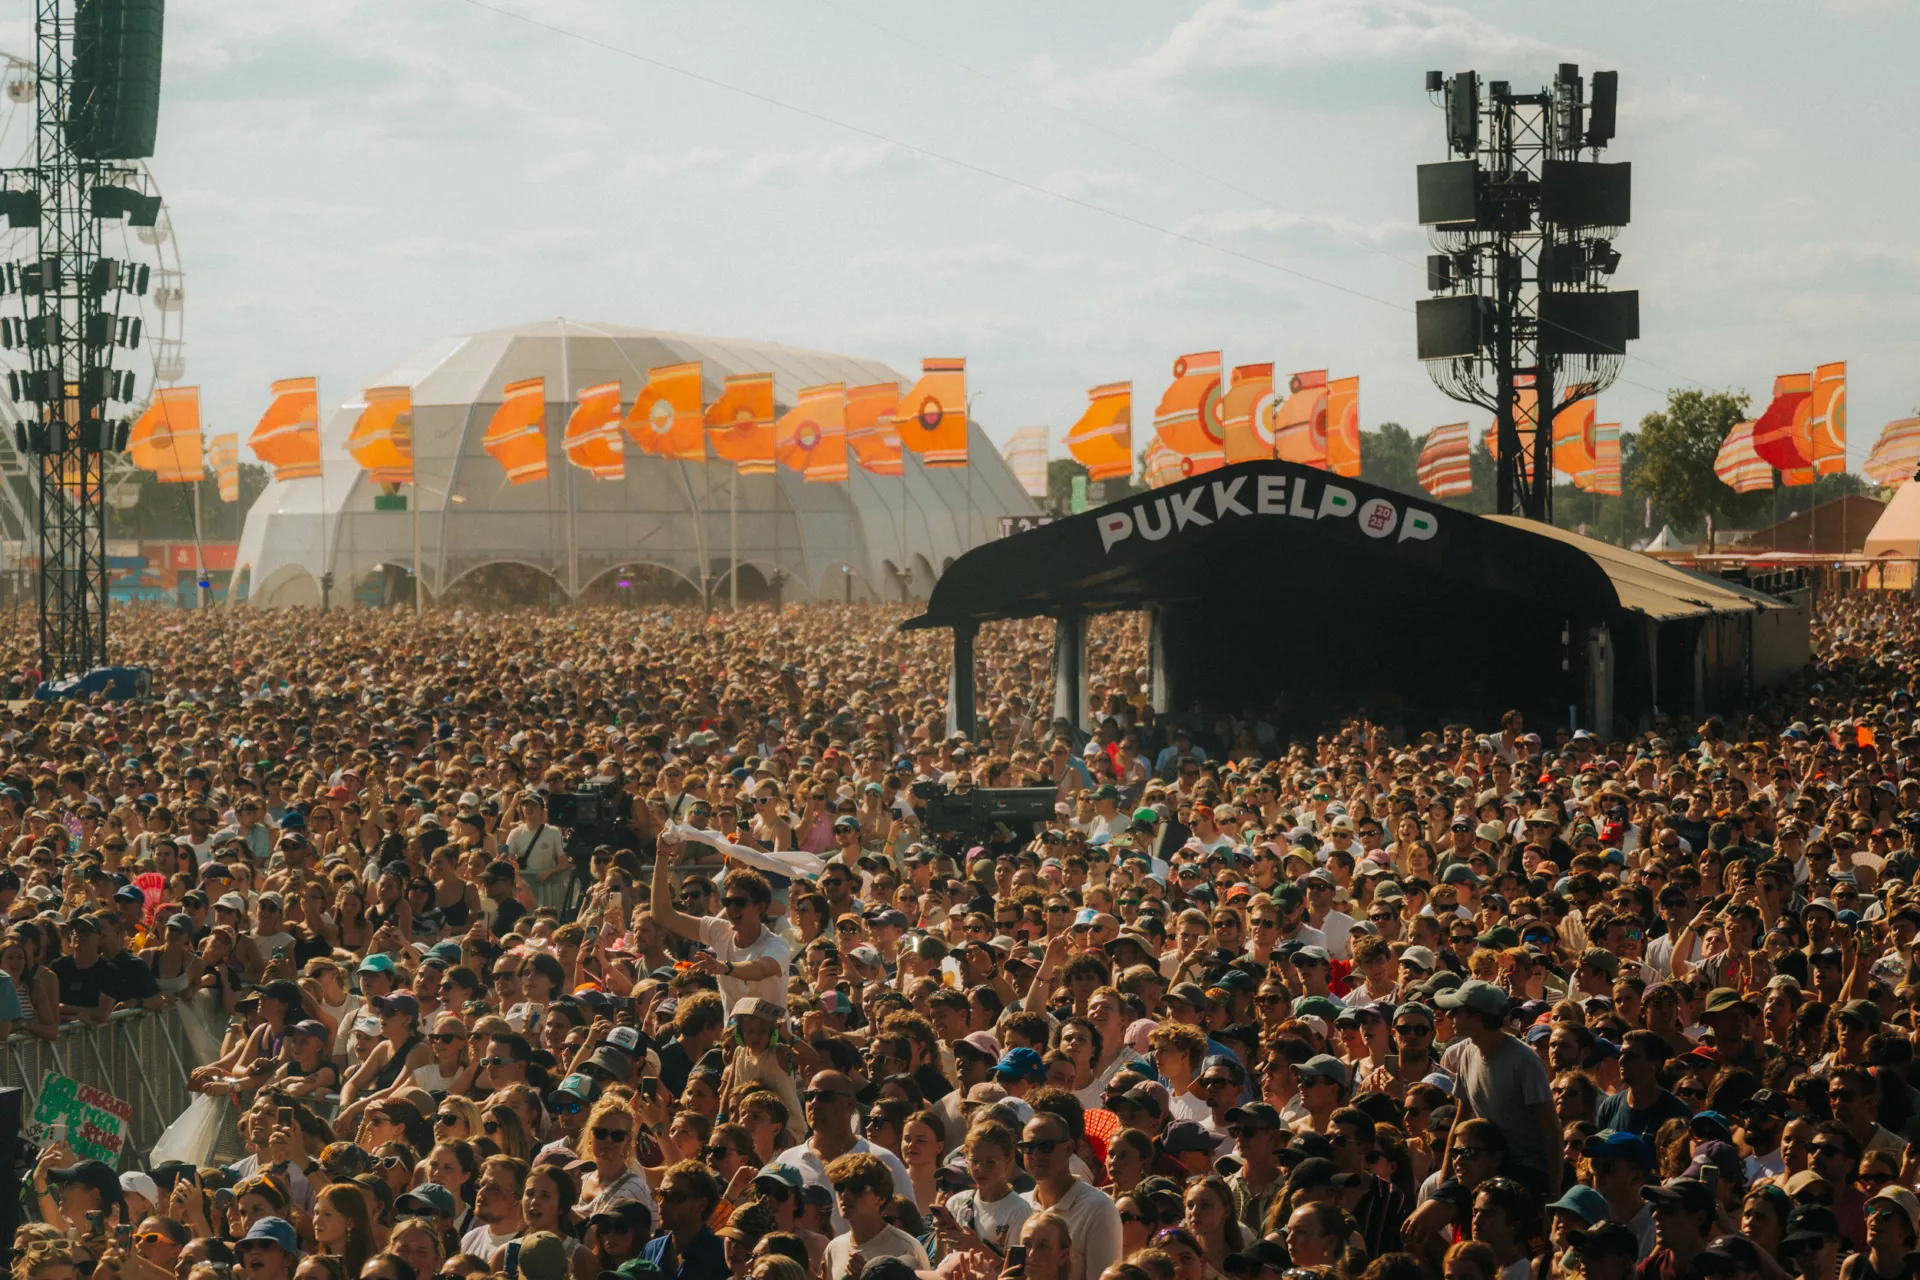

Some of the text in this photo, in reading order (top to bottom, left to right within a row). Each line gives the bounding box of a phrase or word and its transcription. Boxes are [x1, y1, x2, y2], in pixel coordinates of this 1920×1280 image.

[1096, 475, 1438, 555] PUKKELPOP
[138, 875, 162, 890] CLUB
[26, 1123, 43, 1138] LORE
